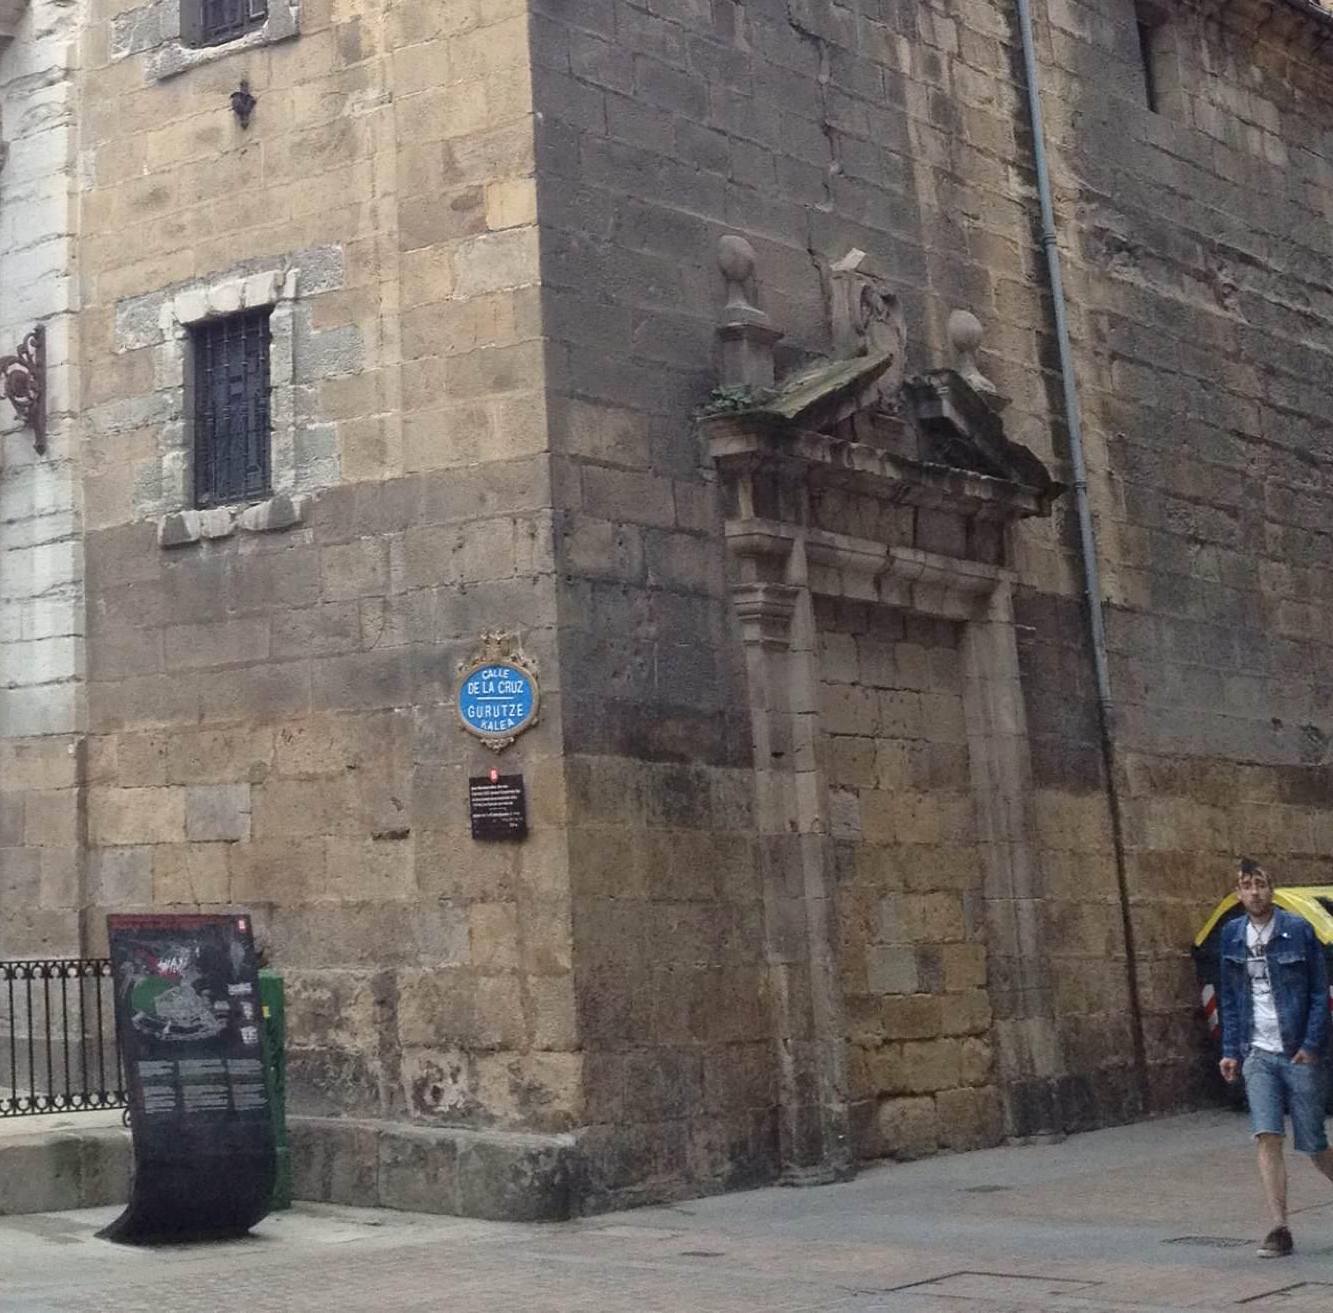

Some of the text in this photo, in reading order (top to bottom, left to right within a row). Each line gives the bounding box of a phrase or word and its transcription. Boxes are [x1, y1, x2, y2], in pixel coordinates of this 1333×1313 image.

[482, 669, 509, 680] CALLE
[468, 681, 524, 695] DE LA CRUZ
[467, 704, 524, 719] GURUTZE
[480, 718, 514, 732] KALEA
